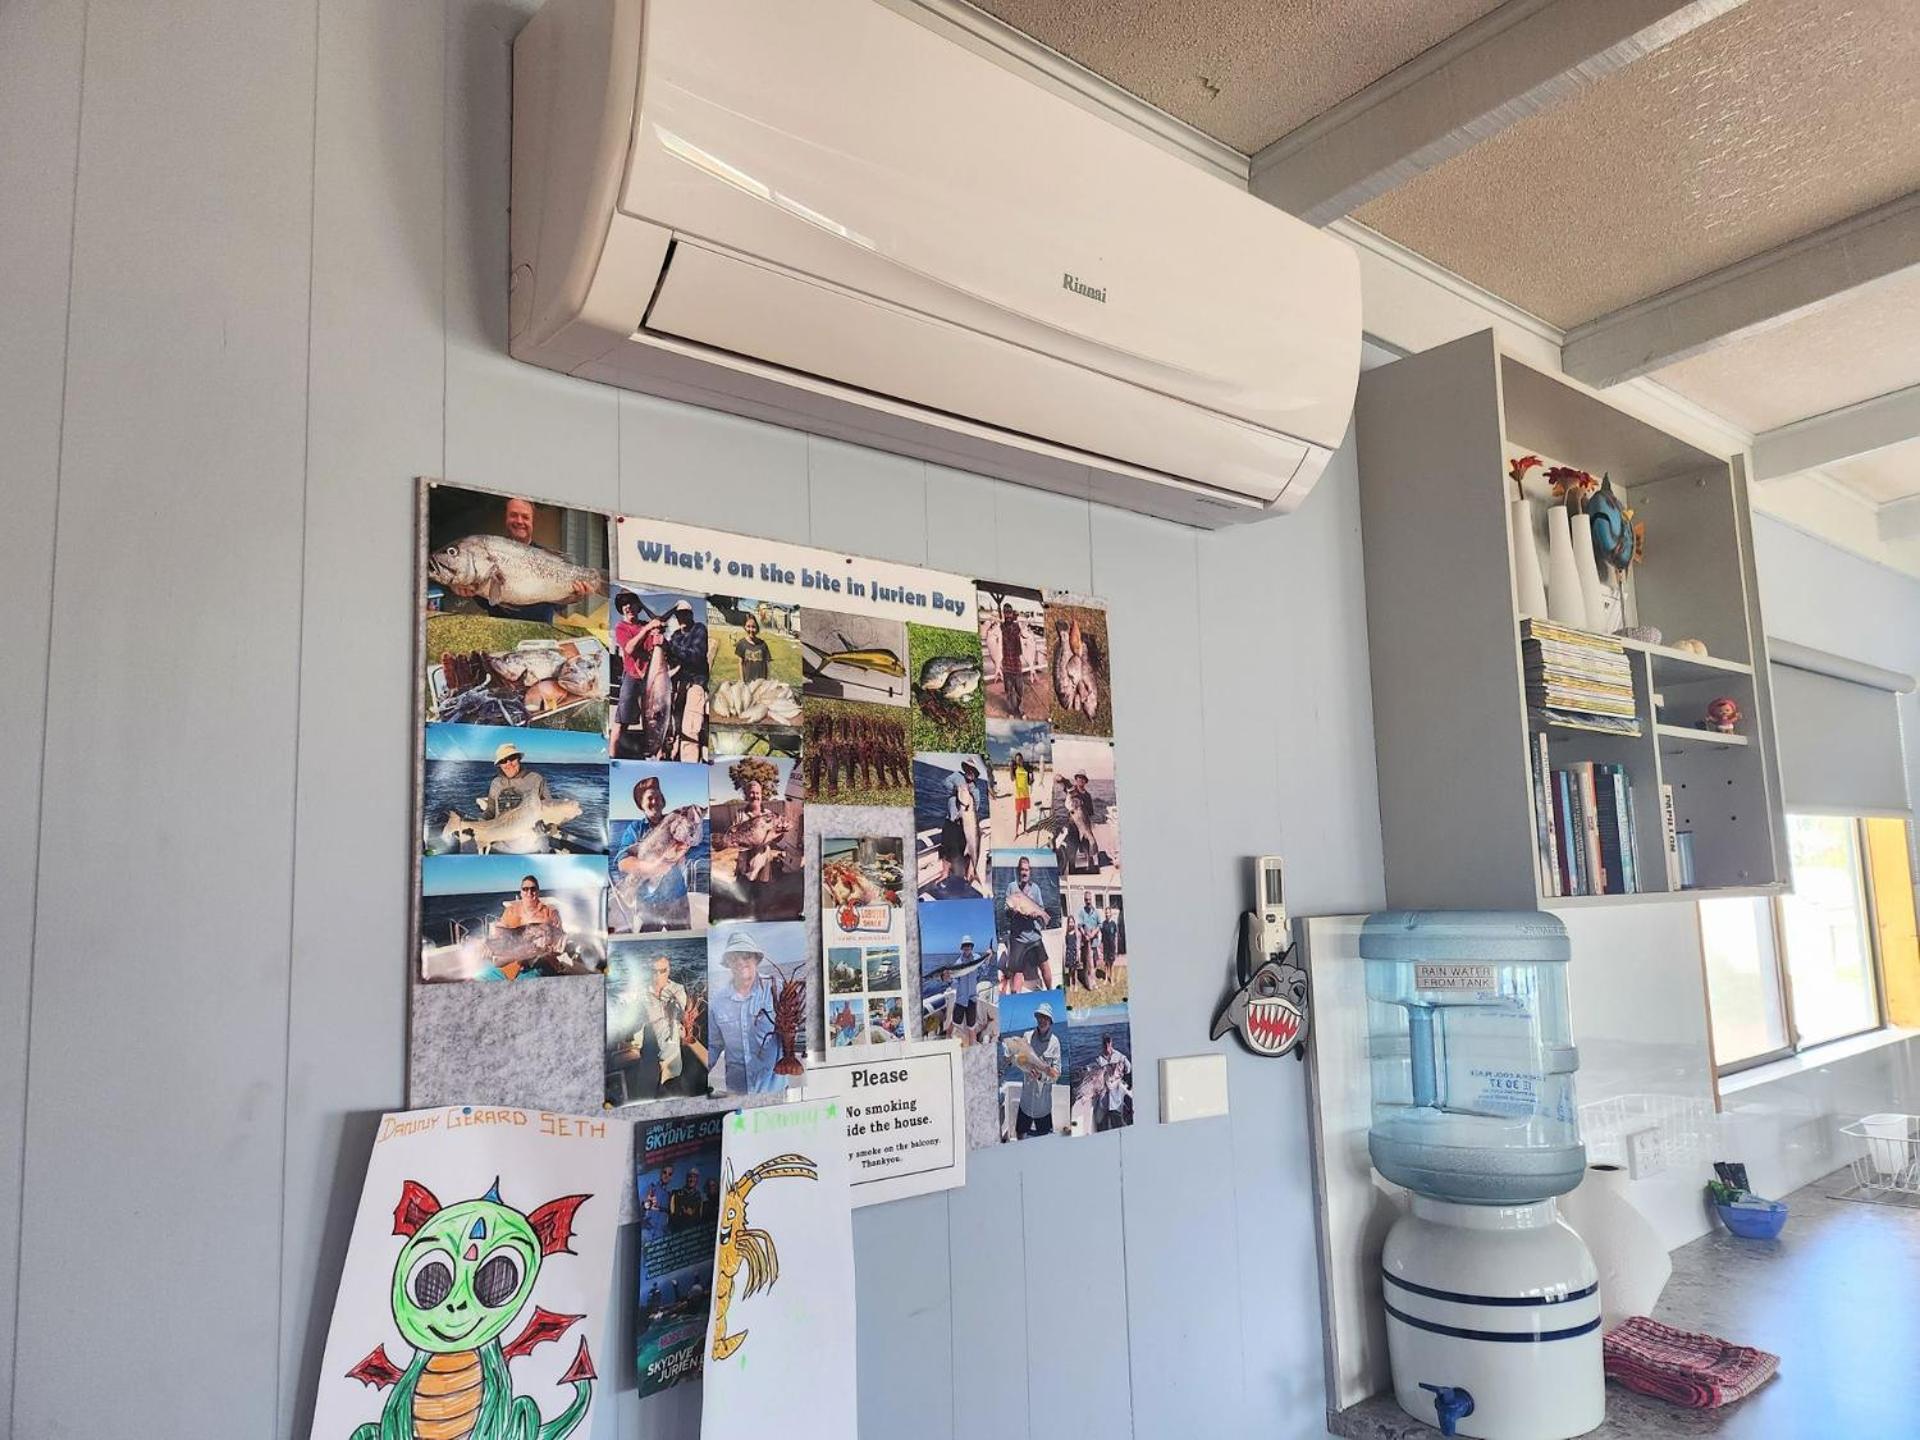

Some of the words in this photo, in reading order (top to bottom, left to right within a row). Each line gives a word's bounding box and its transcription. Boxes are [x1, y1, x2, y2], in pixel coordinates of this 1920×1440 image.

[1063, 272, 1106, 303] Rinnai
[637, 539, 721, 575] What's
[727, 559, 754, 579] on
[760, 562, 796, 585] the
[801, 568, 841, 593] bite
[847, 576, 866, 597] in
[871, 580, 928, 607] Jurien
[932, 591, 966, 616] Bay
[1421, 967, 1447, 976] RAIN
[1451, 967, 1491, 976] WATER
[1424, 978, 1456, 987] FROM
[1461, 978, 1489, 988] TANK
[851, 1069, 908, 1088] Please
[846, 1106, 861, 1118] No
[865, 1099, 917, 1116] smoking
[447, 1107, 528, 1130] GERARD
[539, 1112, 606, 1138] SETH
[847, 1123, 866, 1137] ide
[870, 1120, 890, 1133] the
[894, 1116, 933, 1130] house.
[645, 1124, 695, 1151] SKYDIVE
[698, 1119, 722, 1137] SOL
[856, 1147, 881, 1158] smoke
[896, 1143, 909, 1152] the
[647, 1345, 695, 1376] SKYDIVE
[658, 1356, 698, 1383] JURIEN
